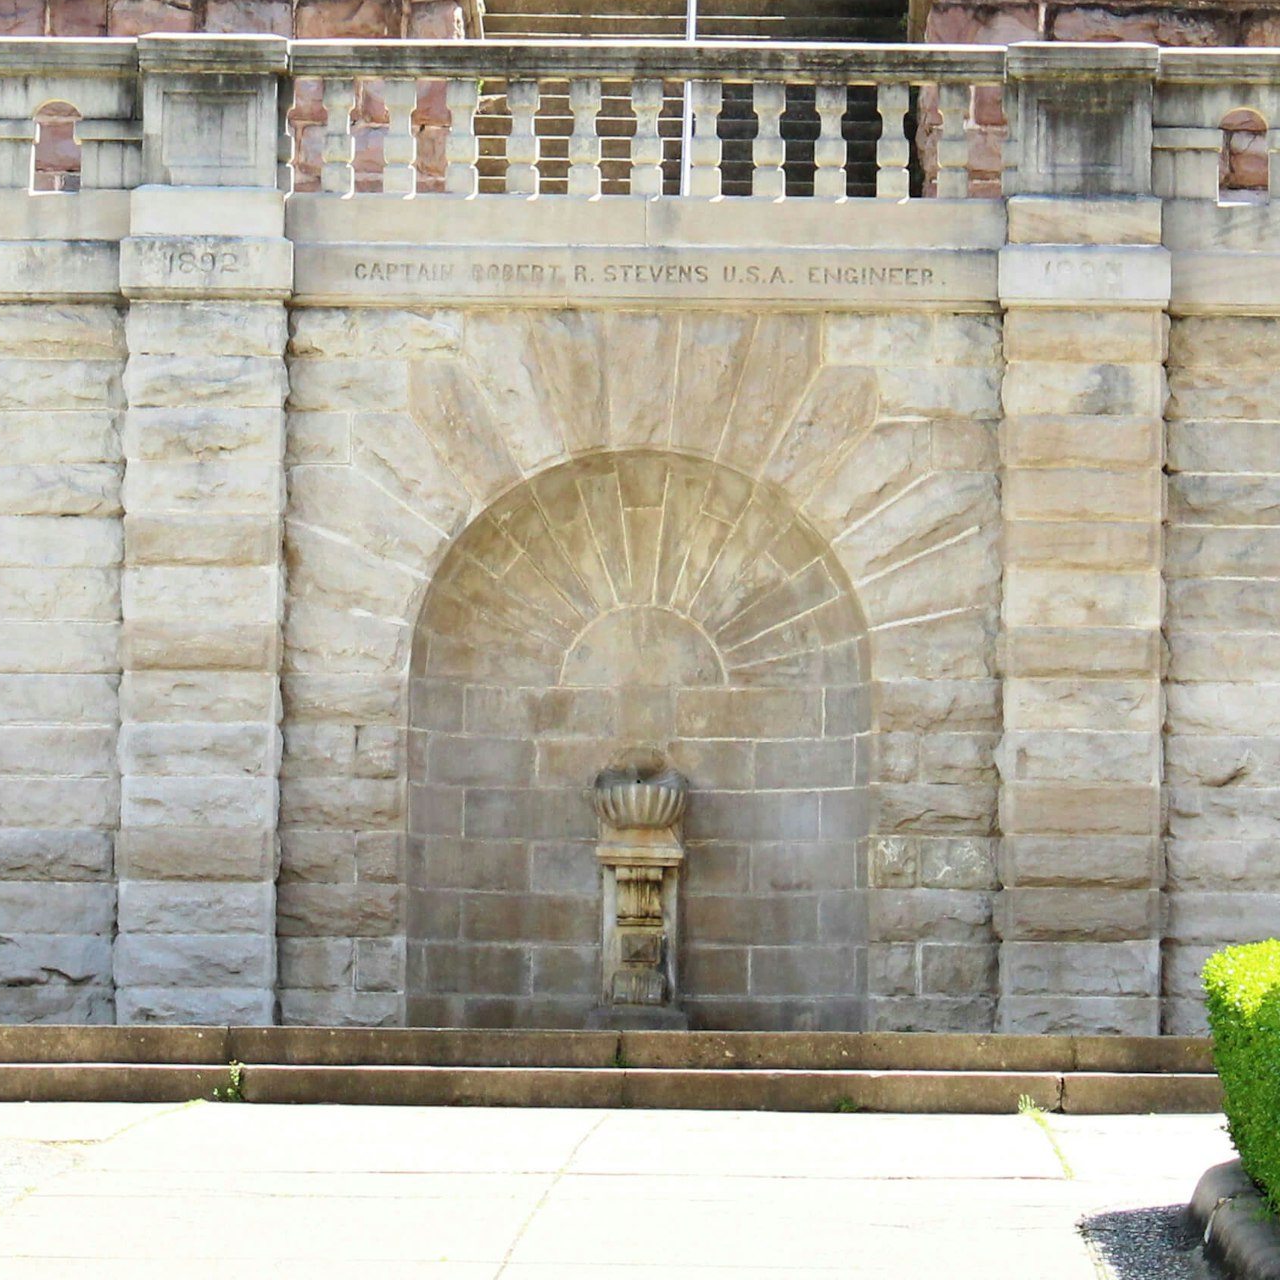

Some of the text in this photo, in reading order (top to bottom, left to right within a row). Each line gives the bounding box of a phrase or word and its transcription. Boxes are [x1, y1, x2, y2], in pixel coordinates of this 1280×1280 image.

[165, 251, 239, 273] 1892
[354, 263, 455, 281] CAPTAIN
[472, 264, 560, 282] ROBERT
[574, 264, 595, 283] R.
[604, 265, 709, 283] STEVENS
[723, 266, 794, 284] U.S.A.
